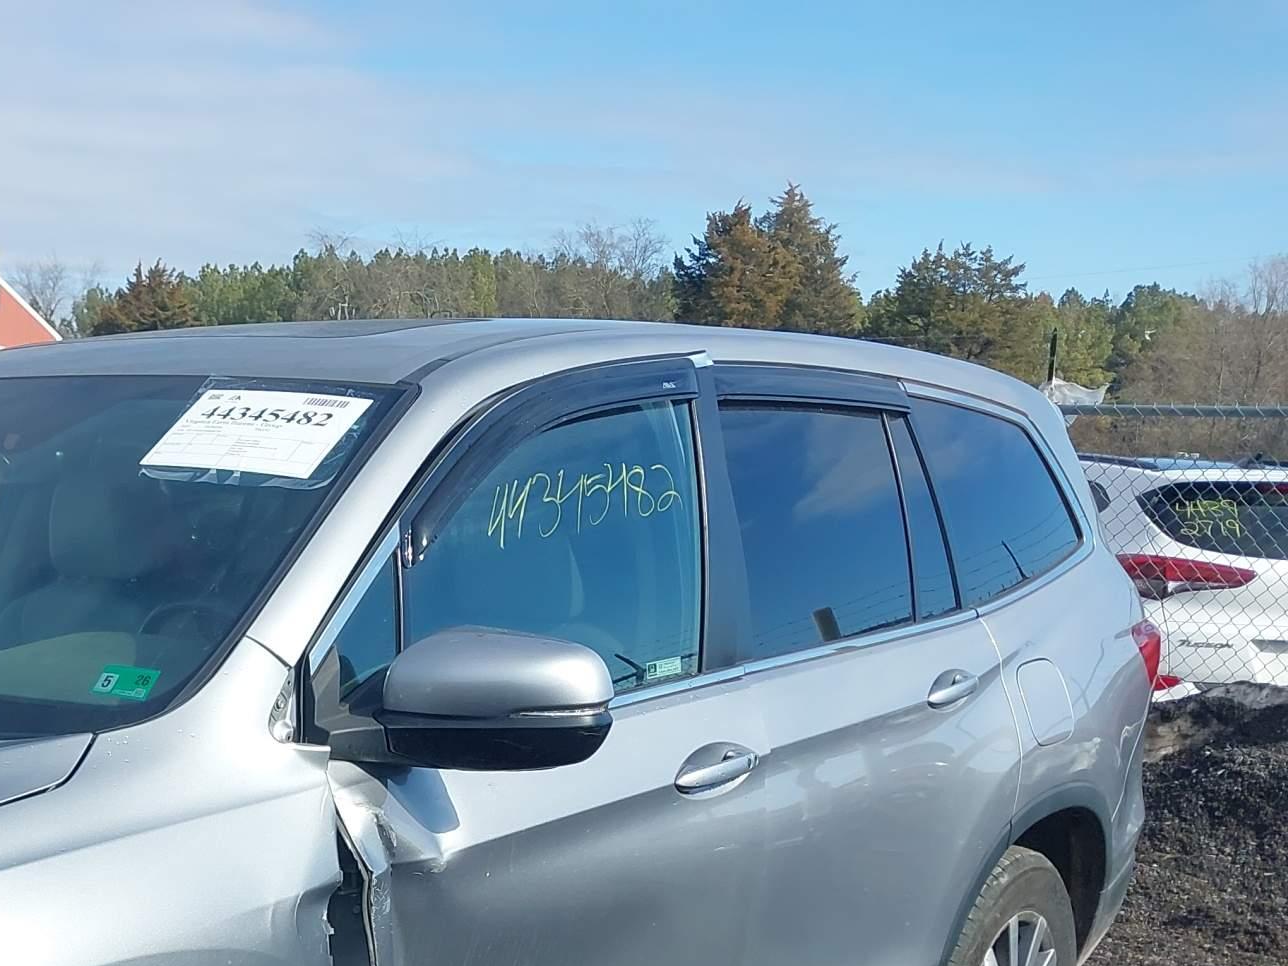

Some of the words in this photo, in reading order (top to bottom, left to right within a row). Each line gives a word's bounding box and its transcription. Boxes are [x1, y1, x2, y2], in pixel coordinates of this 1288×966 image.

[200, 404, 334, 427] 44345482
[487, 462, 684, 549] 44345482
[1180, 519, 1241, 538] 2719
[100, 675, 114, 688] 5
[135, 674, 152, 687] 26
